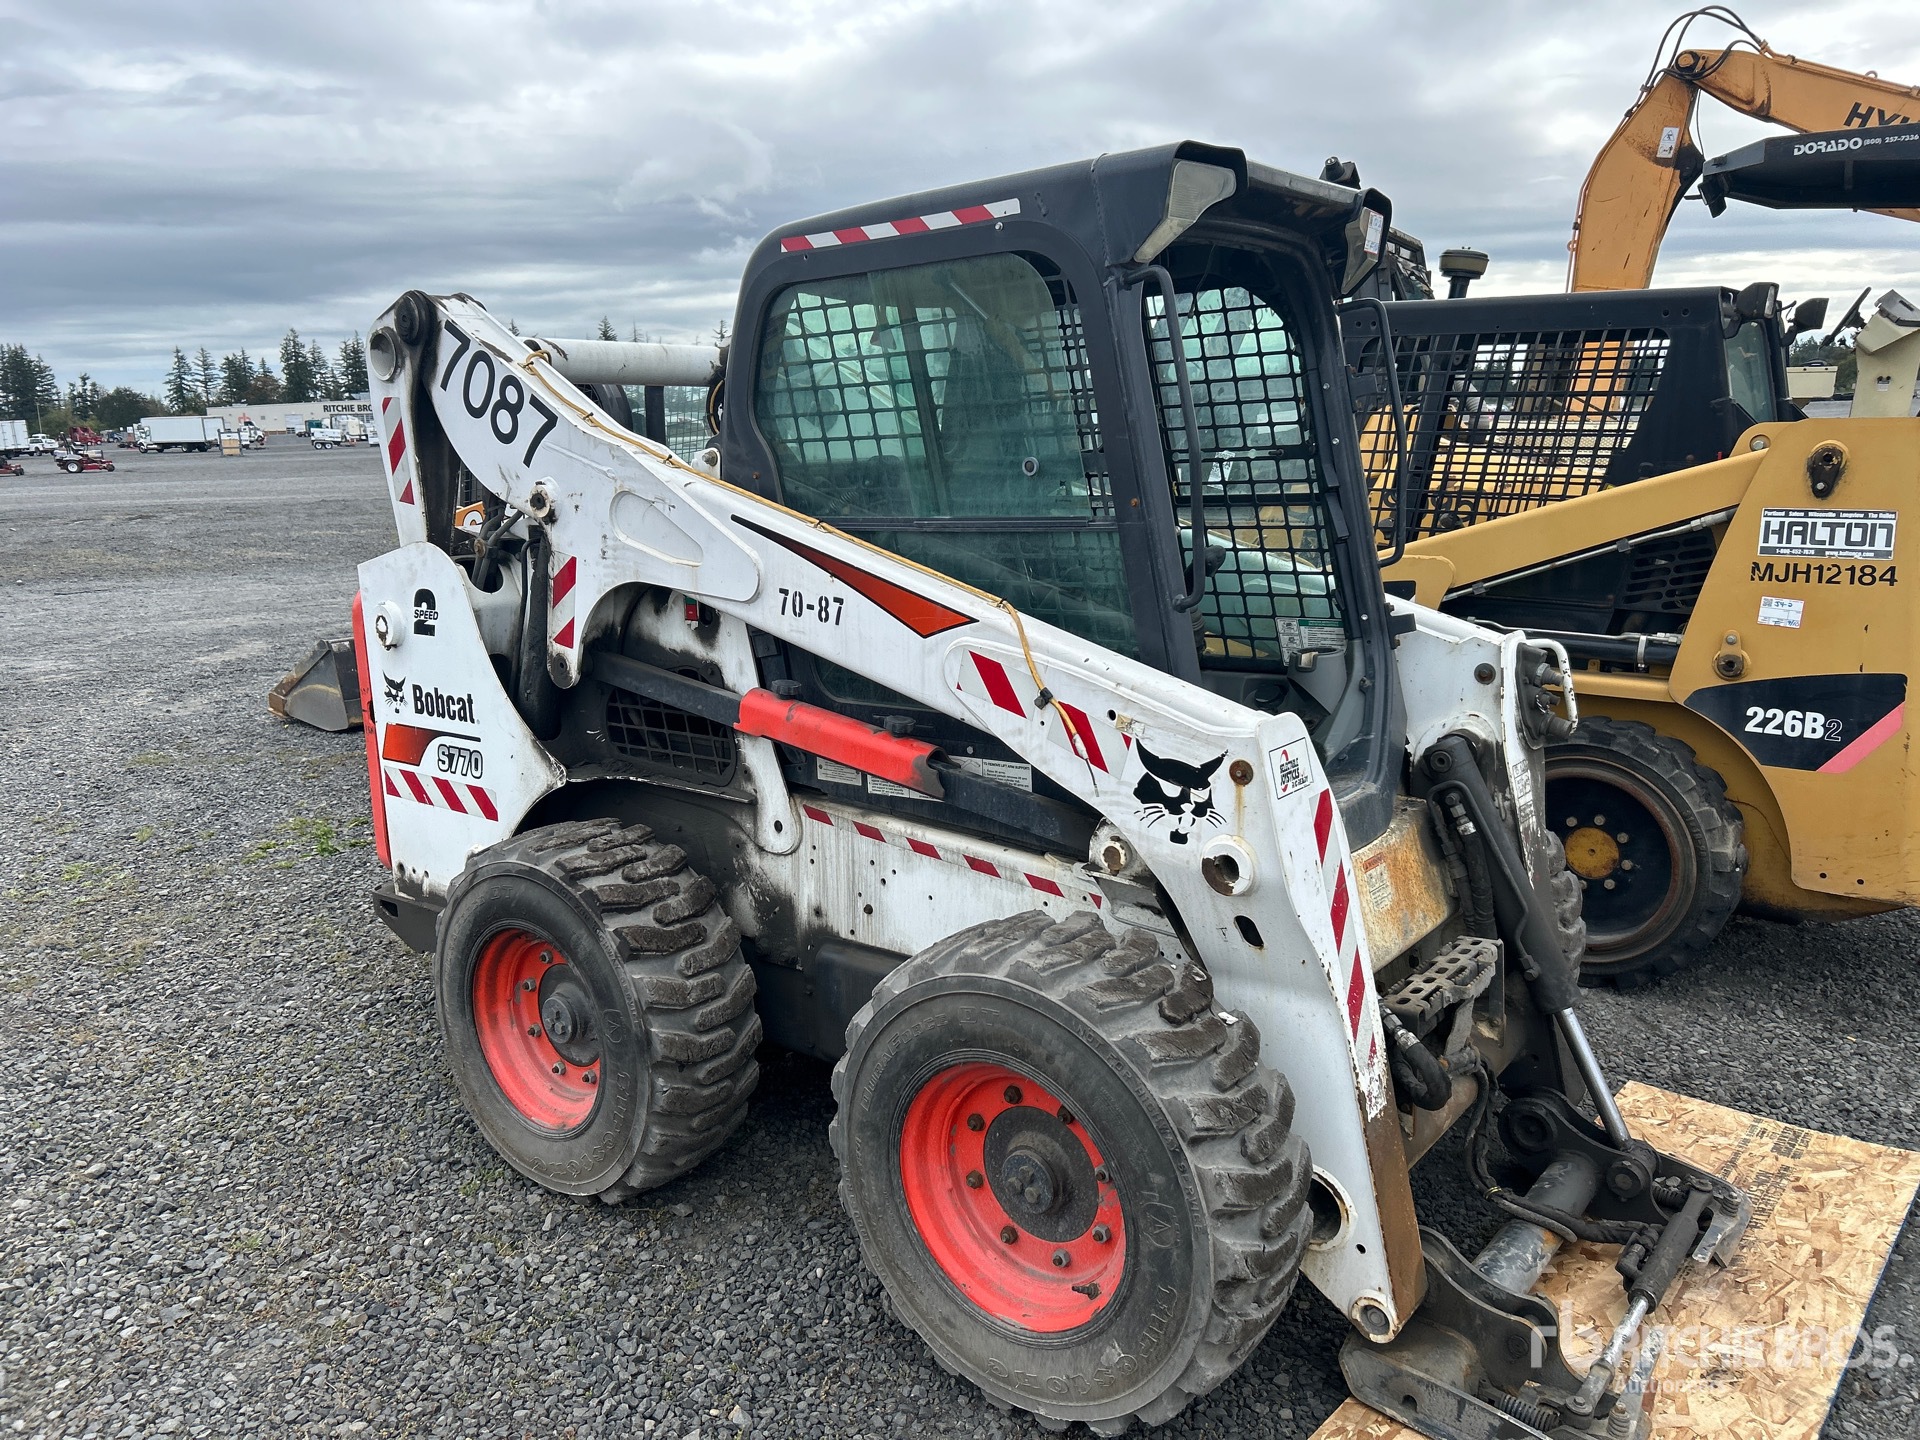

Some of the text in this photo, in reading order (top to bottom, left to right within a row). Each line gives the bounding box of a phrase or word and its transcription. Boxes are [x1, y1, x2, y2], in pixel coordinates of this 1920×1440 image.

[1844, 102, 1910, 128] HY
[1793, 137, 1862, 156] DORADO
[1863, 137, 1882, 146] (800)
[440, 319, 559, 468] 7087
[323, 404, 373, 412] RITCHIE BRO
[1762, 520, 1894, 548] HALTON
[1750, 562, 1898, 587] MJH12184
[413, 588, 436, 637] 2
[413, 609, 439, 621] SPEED
[778, 587, 844, 626] 70-87
[412, 683, 475, 725] Bobcat
[437, 744, 483, 780] S770
